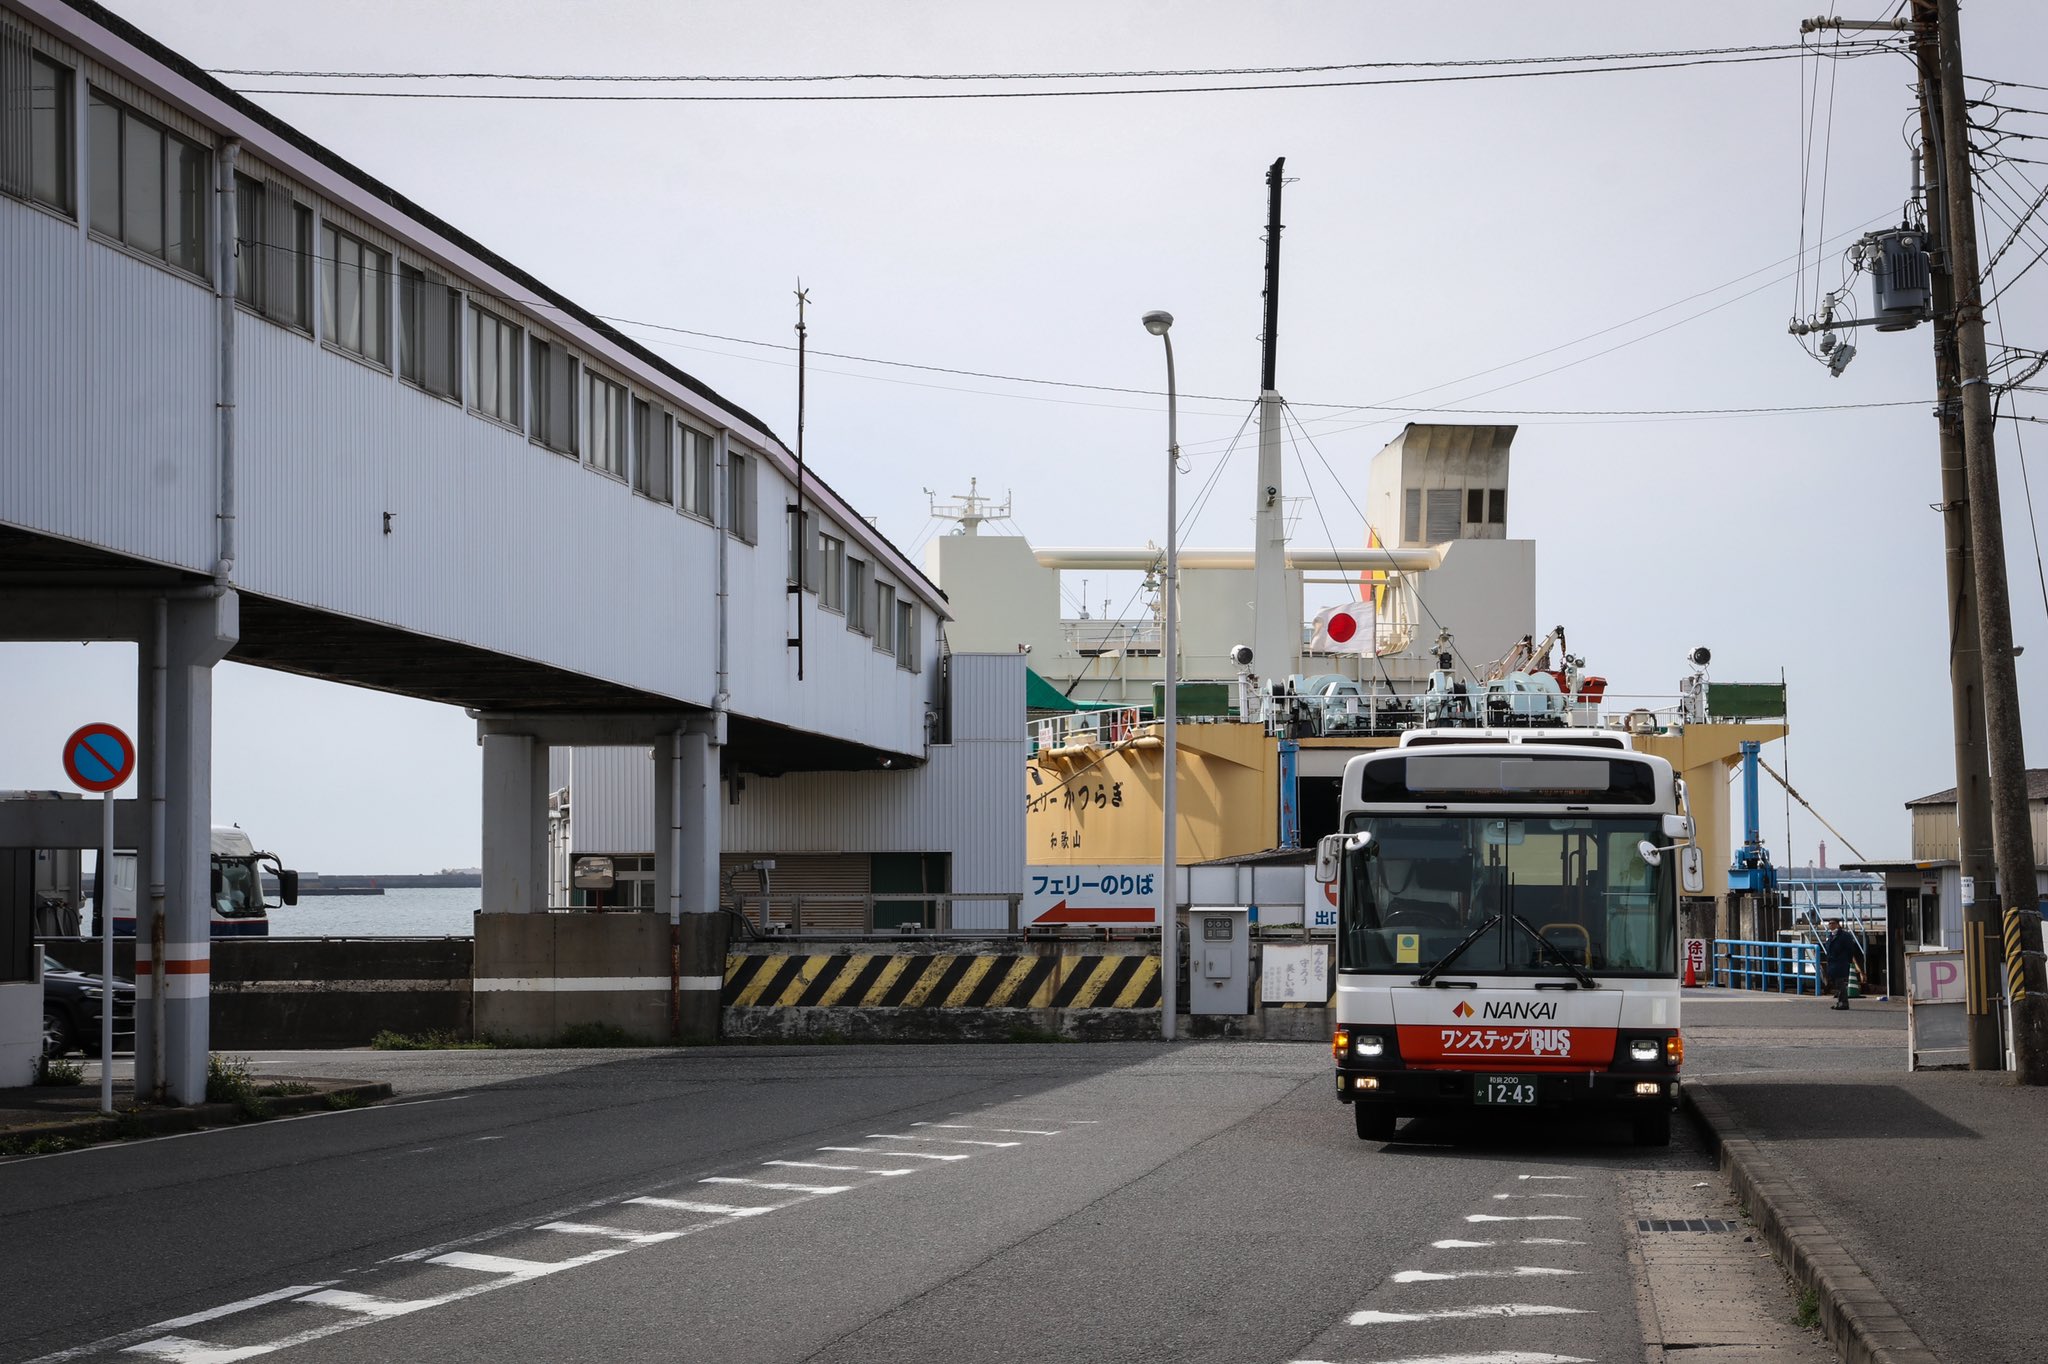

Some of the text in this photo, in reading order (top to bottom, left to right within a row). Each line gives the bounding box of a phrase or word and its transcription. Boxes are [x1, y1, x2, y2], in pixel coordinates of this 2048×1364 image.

[1050, 830, 1081, 849] 和歌山
[1032, 873, 1154, 896] フェリーのりば
[1929, 961, 1958, 998] P
[1483, 1001, 1557, 1020] NANKAI
[1488, 1084, 1534, 1103] 12-43
